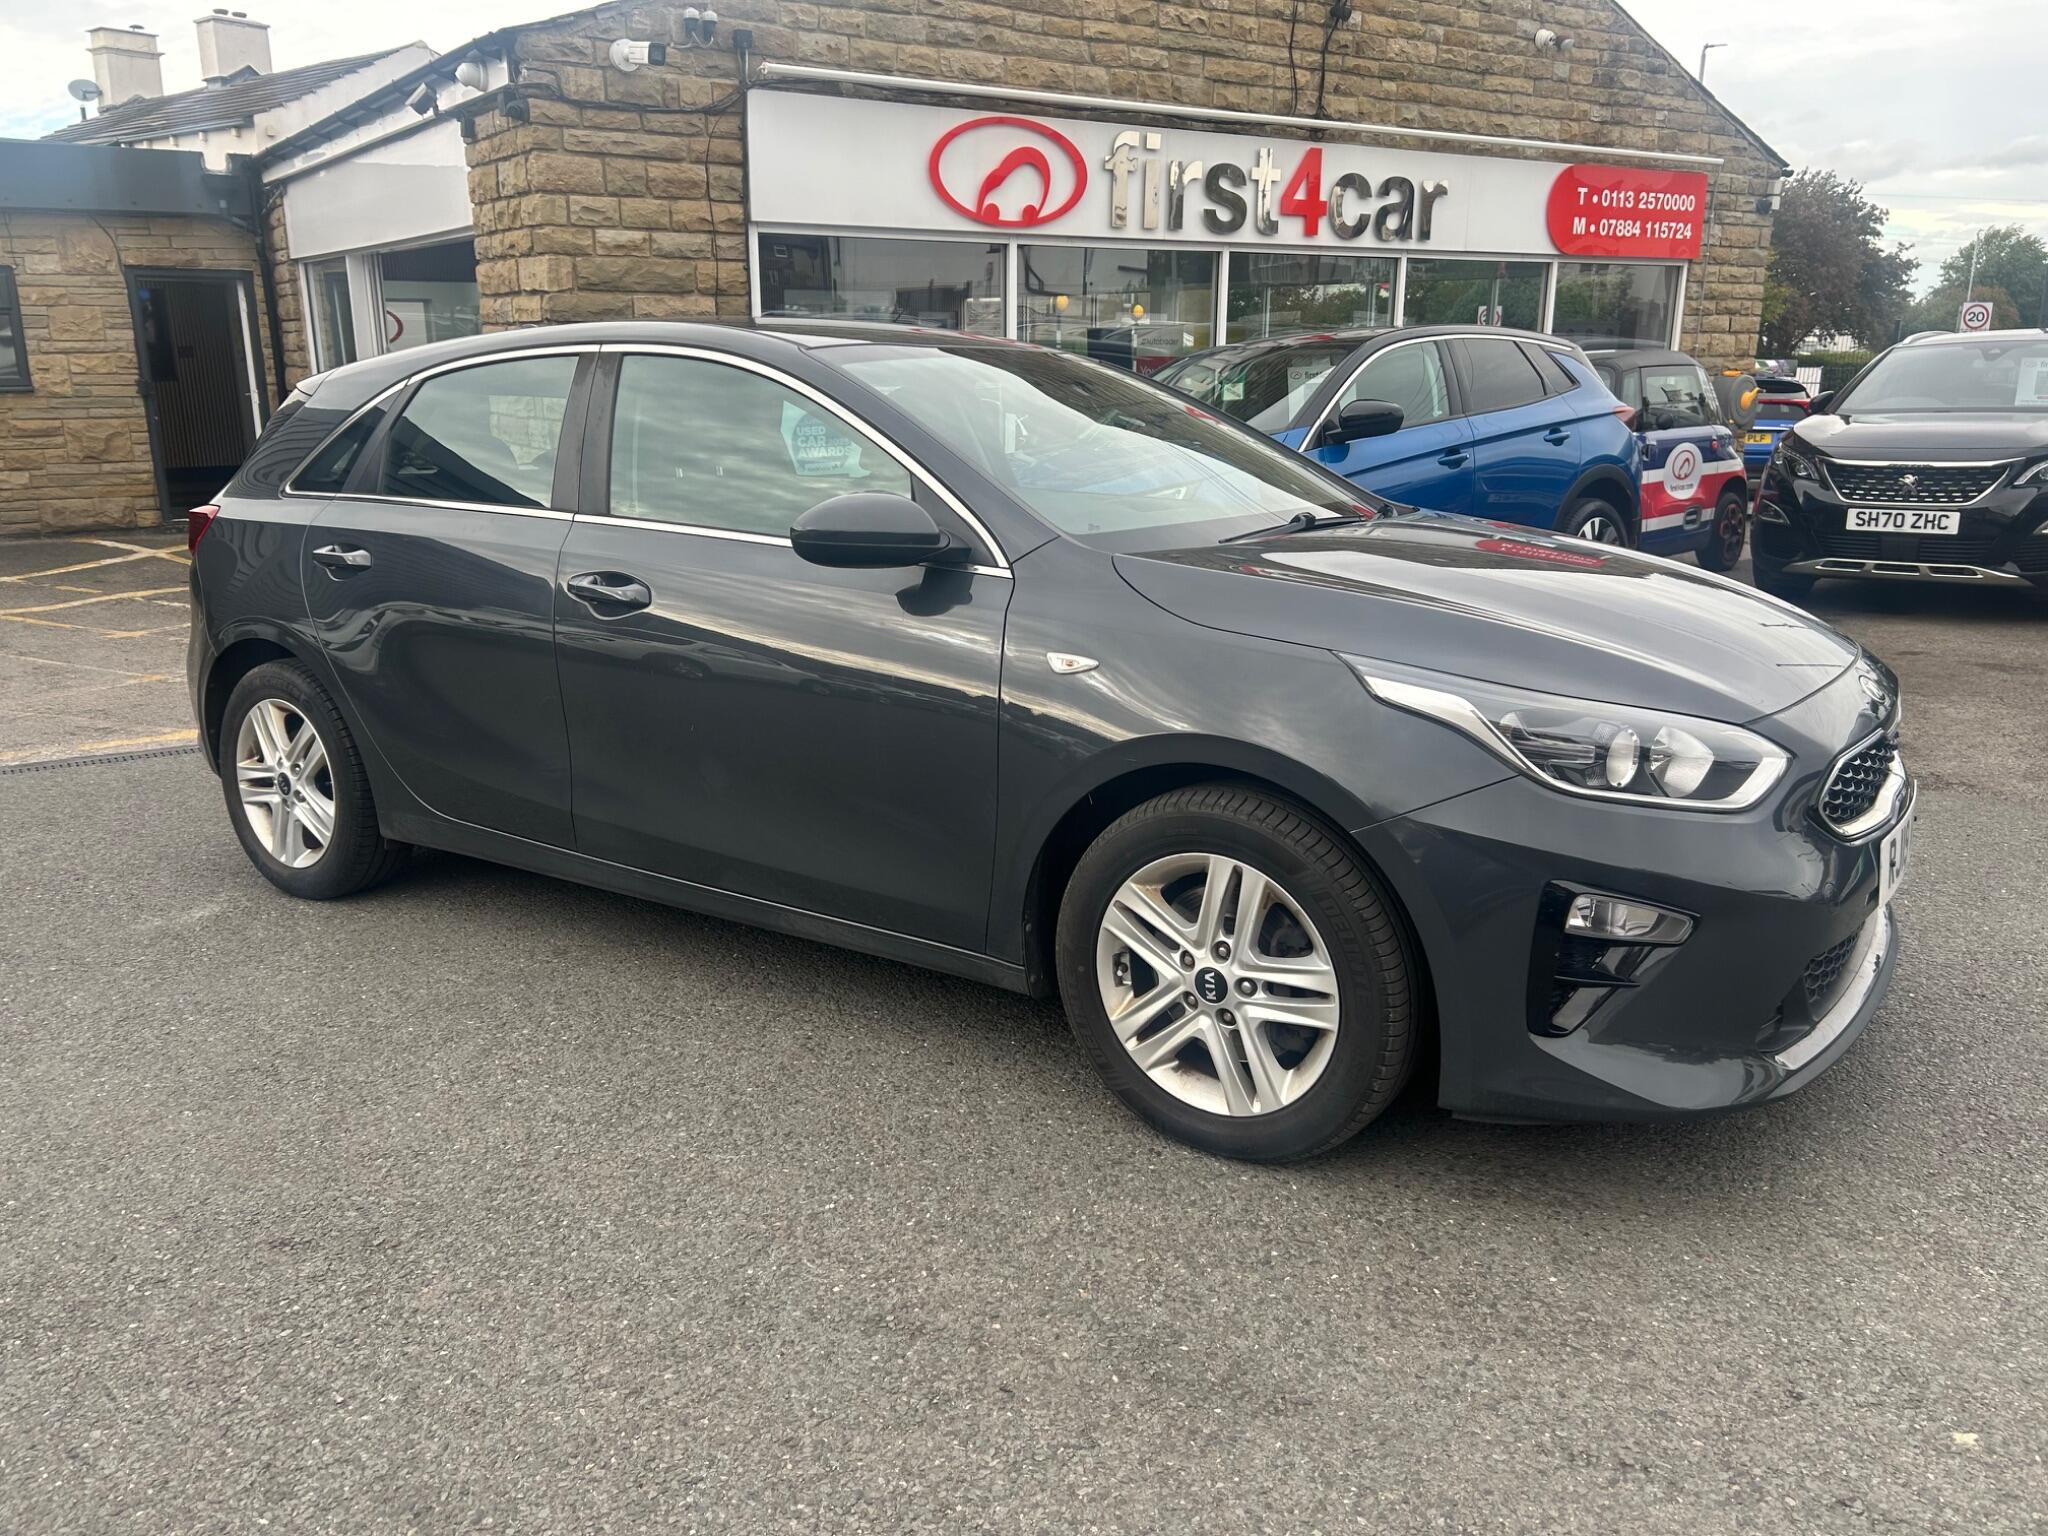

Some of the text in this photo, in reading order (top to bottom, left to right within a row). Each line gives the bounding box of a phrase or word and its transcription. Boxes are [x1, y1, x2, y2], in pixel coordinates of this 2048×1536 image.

[1104, 130, 1450, 242] first4car
[1577, 187, 1696, 212] T 0113 2570000
[1572, 216, 1692, 240] M 07884 115724
[1967, 311, 1986, 323] 20
[796, 426, 826, 435] USED
[1747, 433, 1767, 443] PLF
[798, 436, 826, 447] CAR
[799, 446, 852, 458] AWARDS
[1855, 511, 1950, 530] SH70 ZHC
[1204, 971, 1217, 1001] KIA
